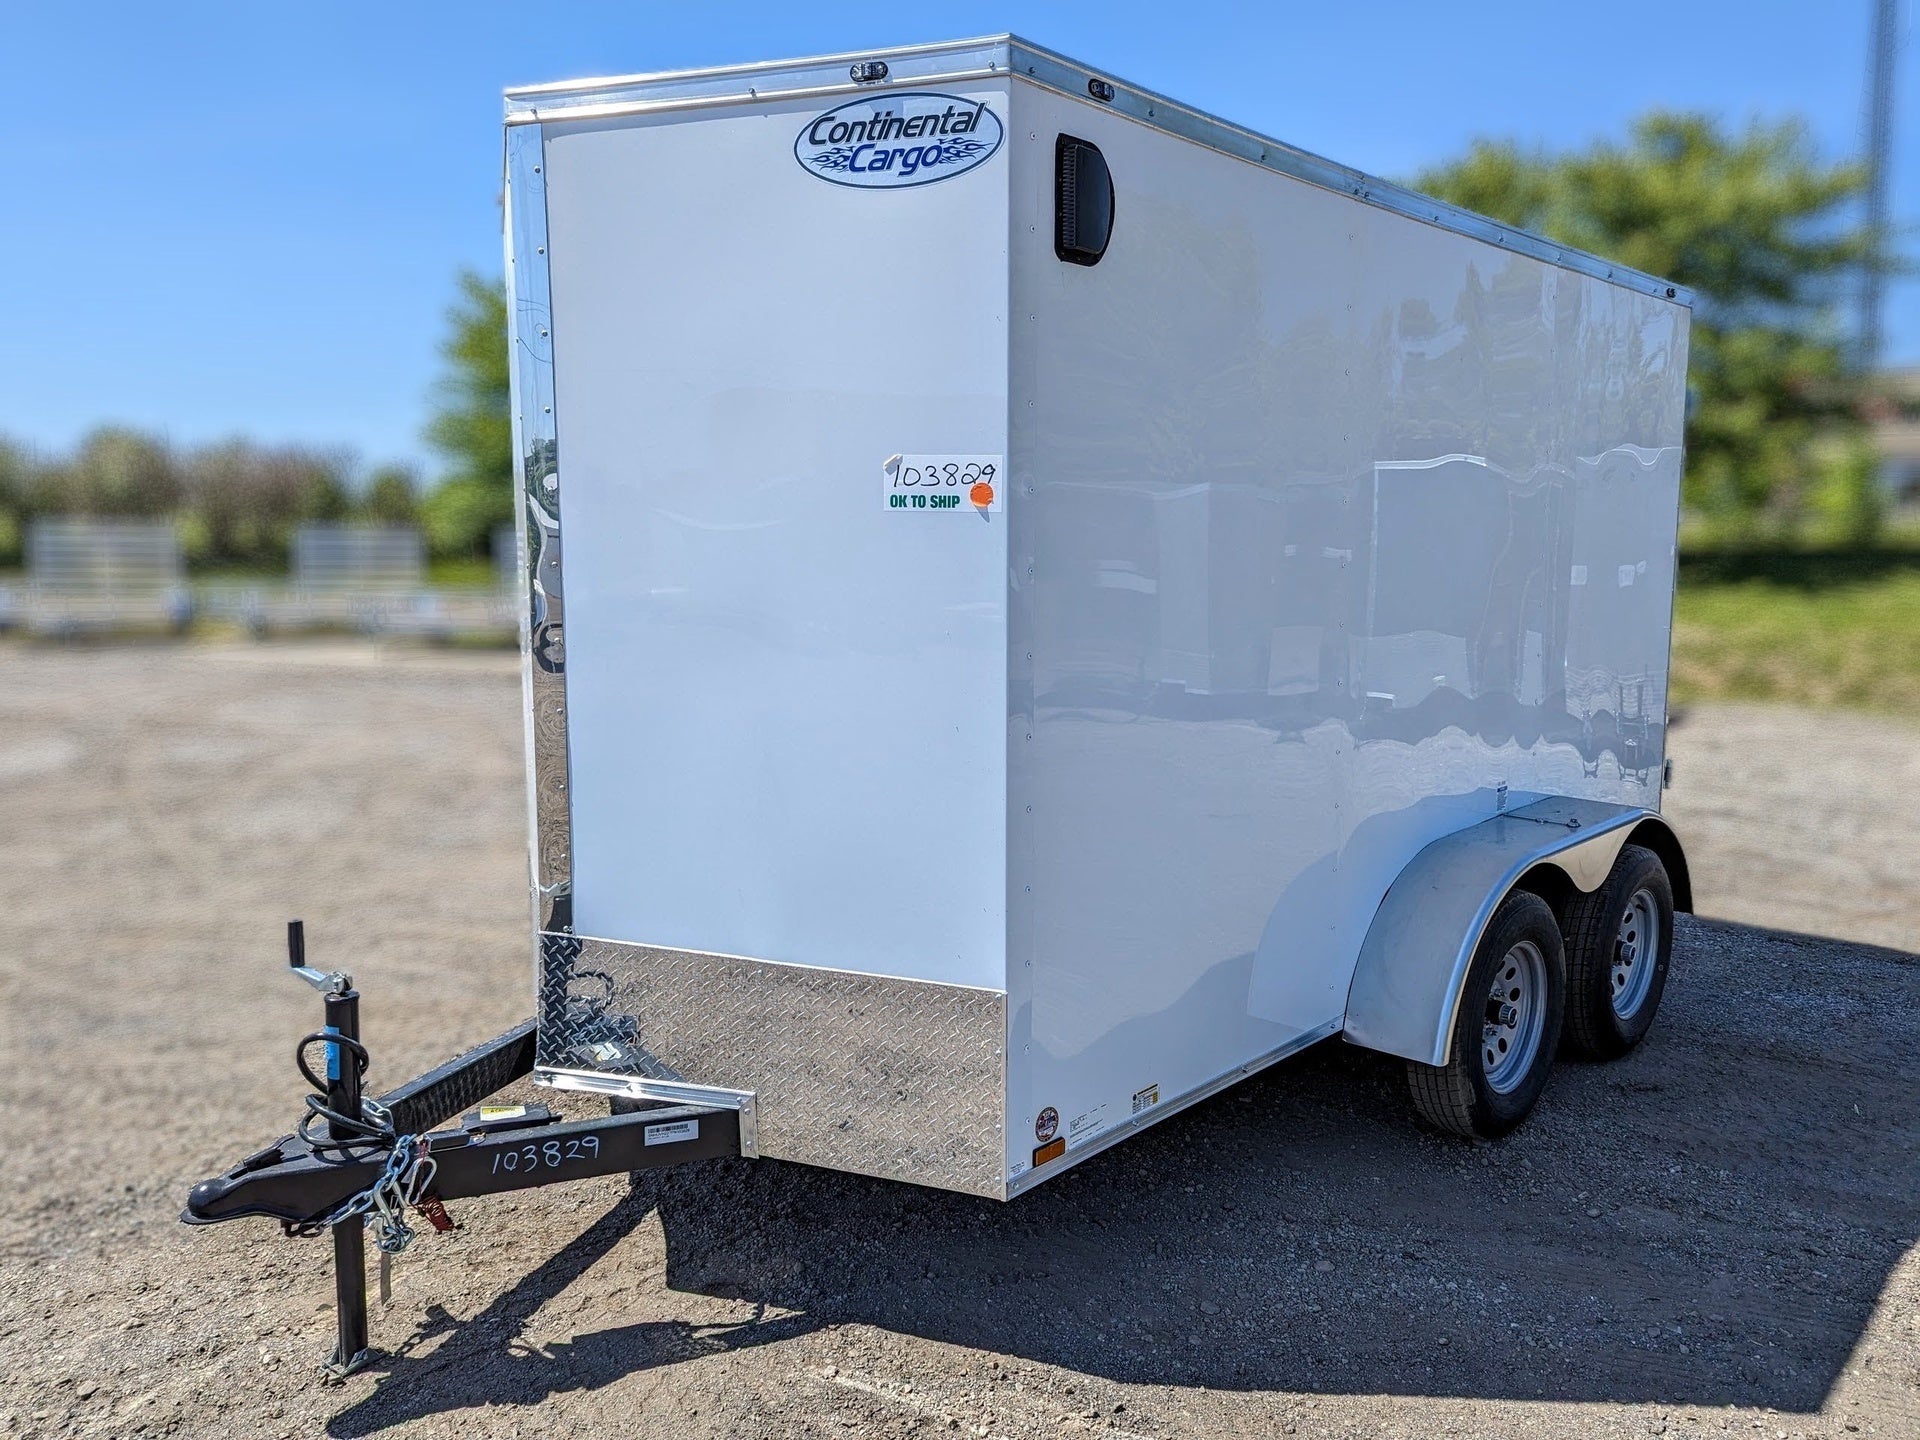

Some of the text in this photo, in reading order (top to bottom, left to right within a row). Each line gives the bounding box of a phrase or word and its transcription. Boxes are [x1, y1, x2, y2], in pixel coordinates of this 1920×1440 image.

[808, 101, 987, 146] Continental
[848, 143, 944, 177] Cargo
[893, 463, 996, 488] 103829
[889, 494, 961, 509] OK TO SHIP
[492, 1135, 600, 1175] 103829
